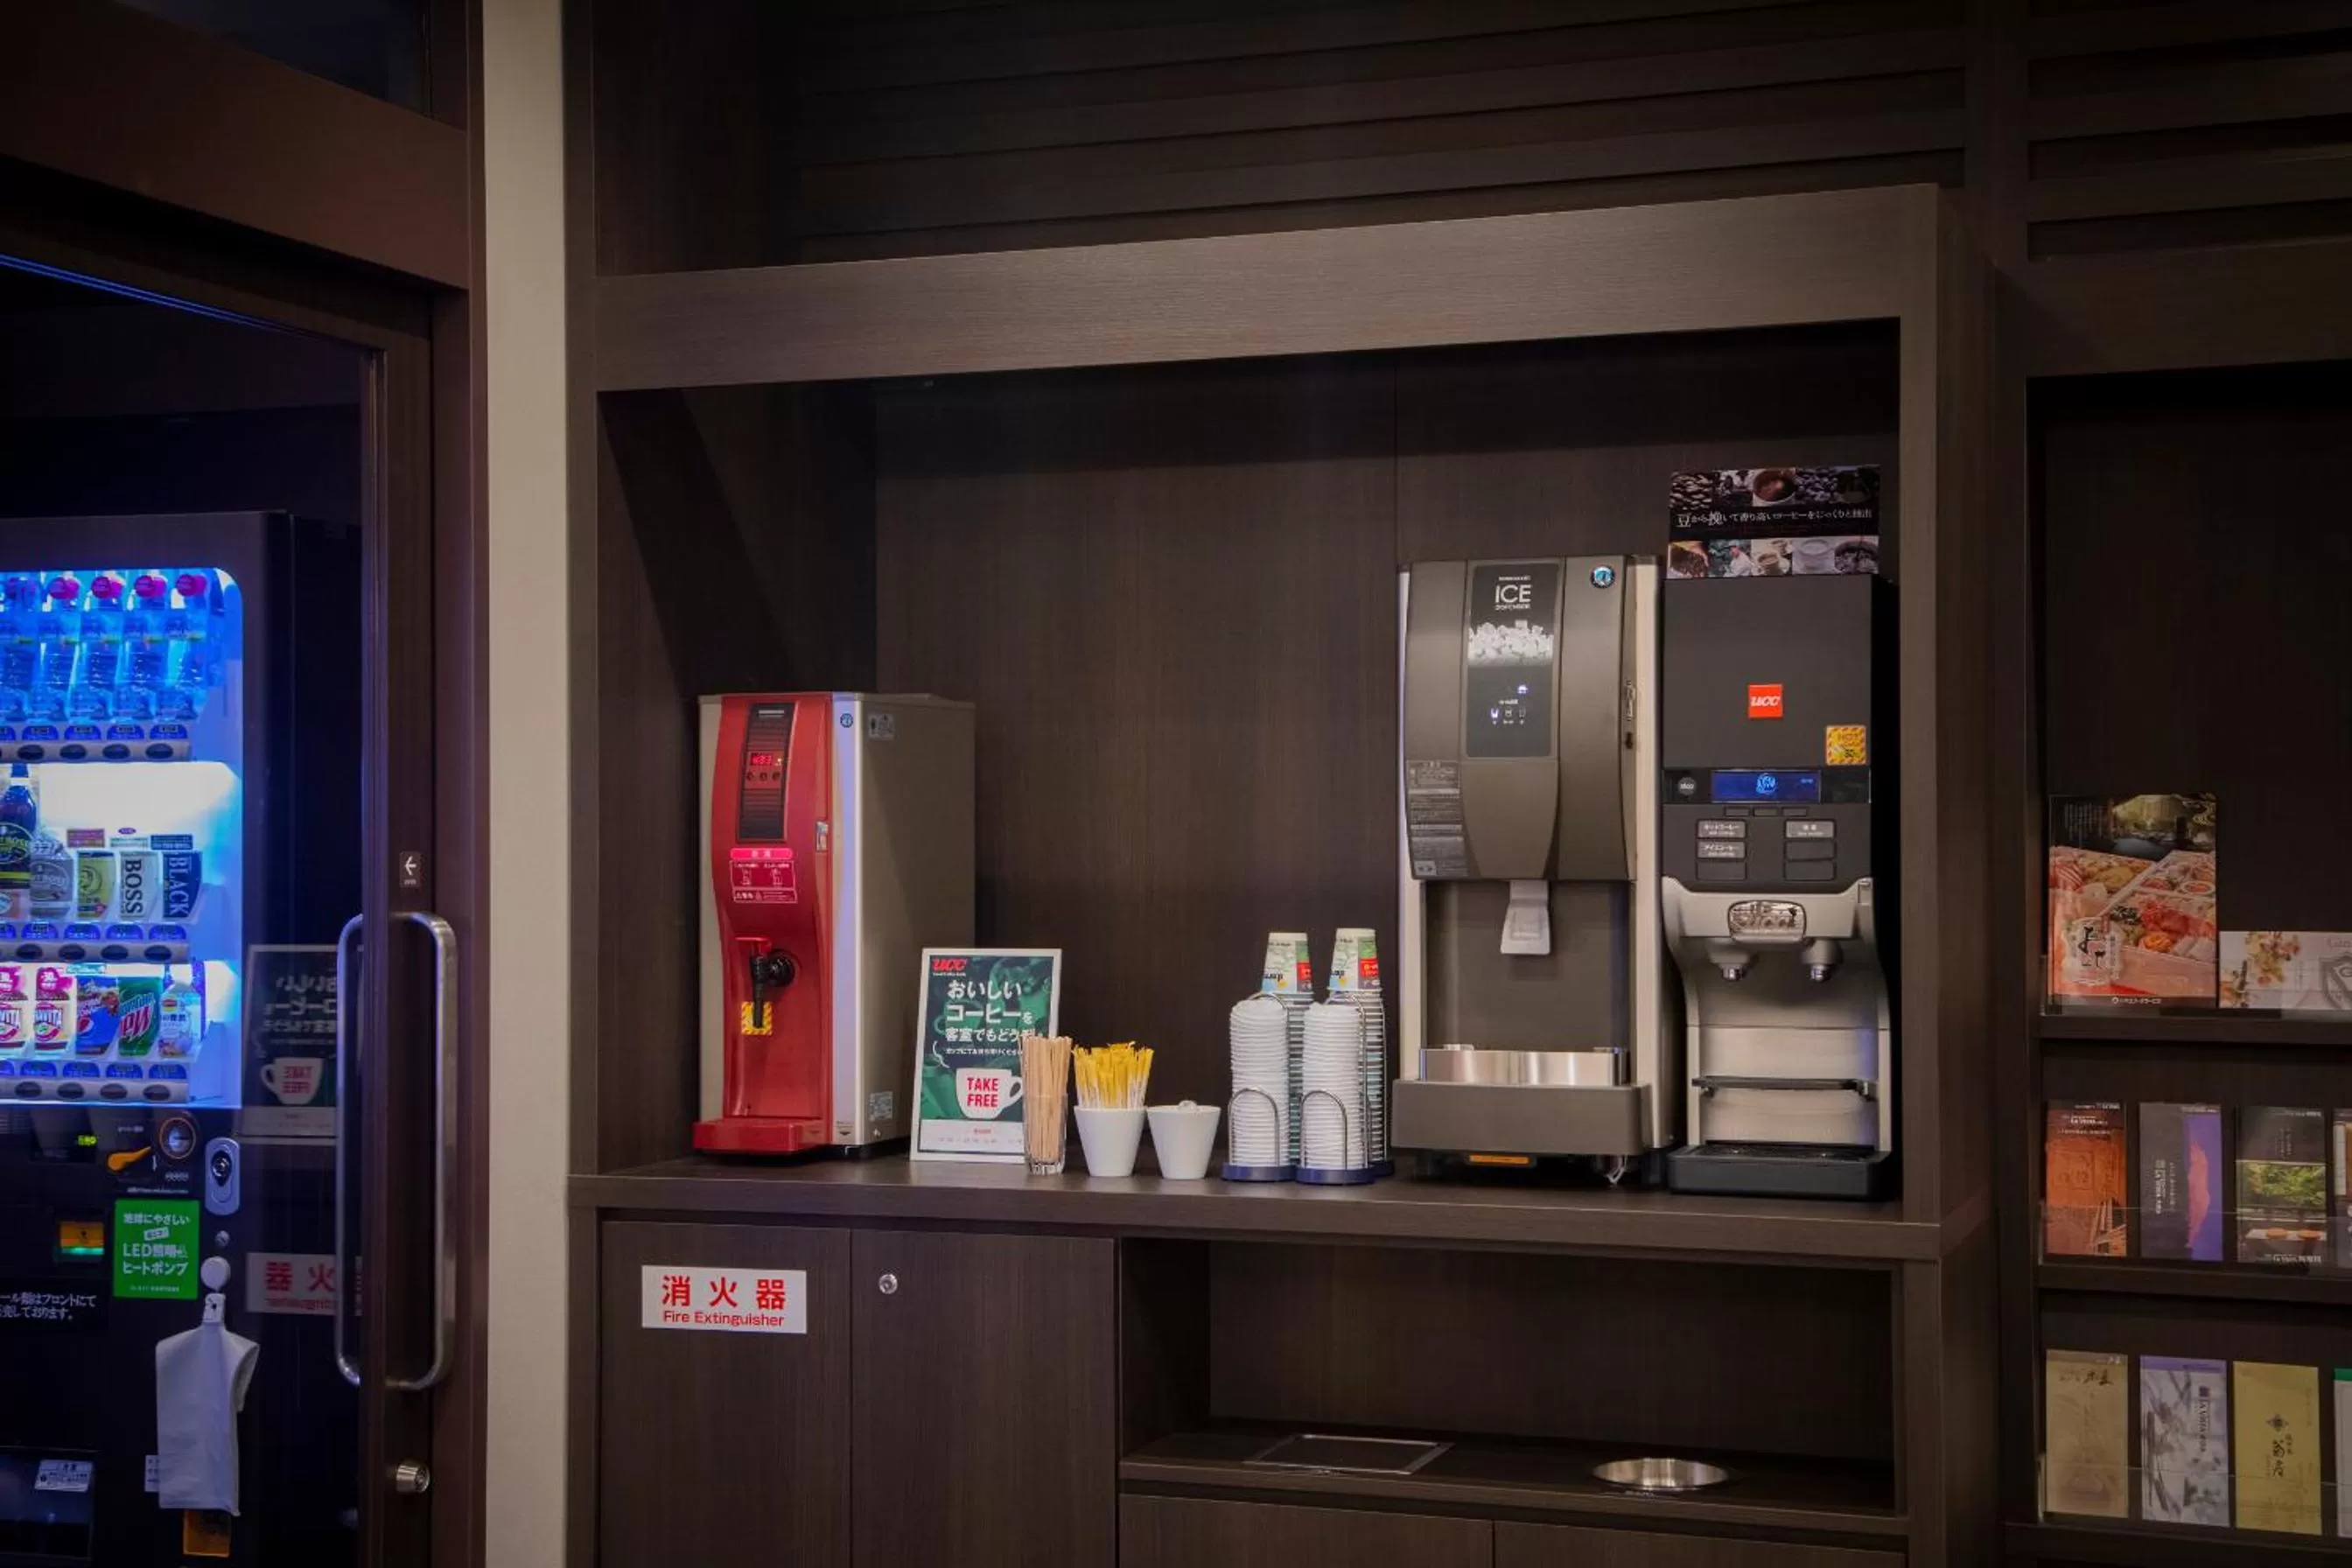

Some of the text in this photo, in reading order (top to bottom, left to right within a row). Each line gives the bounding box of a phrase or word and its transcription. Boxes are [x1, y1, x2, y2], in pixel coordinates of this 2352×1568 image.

[1494, 584, 1531, 604] ICE
[124, 858, 144, 915] BOSS
[168, 856, 192, 917] BLACK
[948, 979, 1022, 1000] おいしい
[946, 1003, 1033, 1025] コーヒーを
[967, 1077, 999, 1092] TAKE
[967, 1094, 998, 1108] FREE
[122, 1260, 189, 1277] ヒートポンプ
[662, 1275, 786, 1311] 消火器
[663, 1310, 785, 1327] Fire Extinguisher
